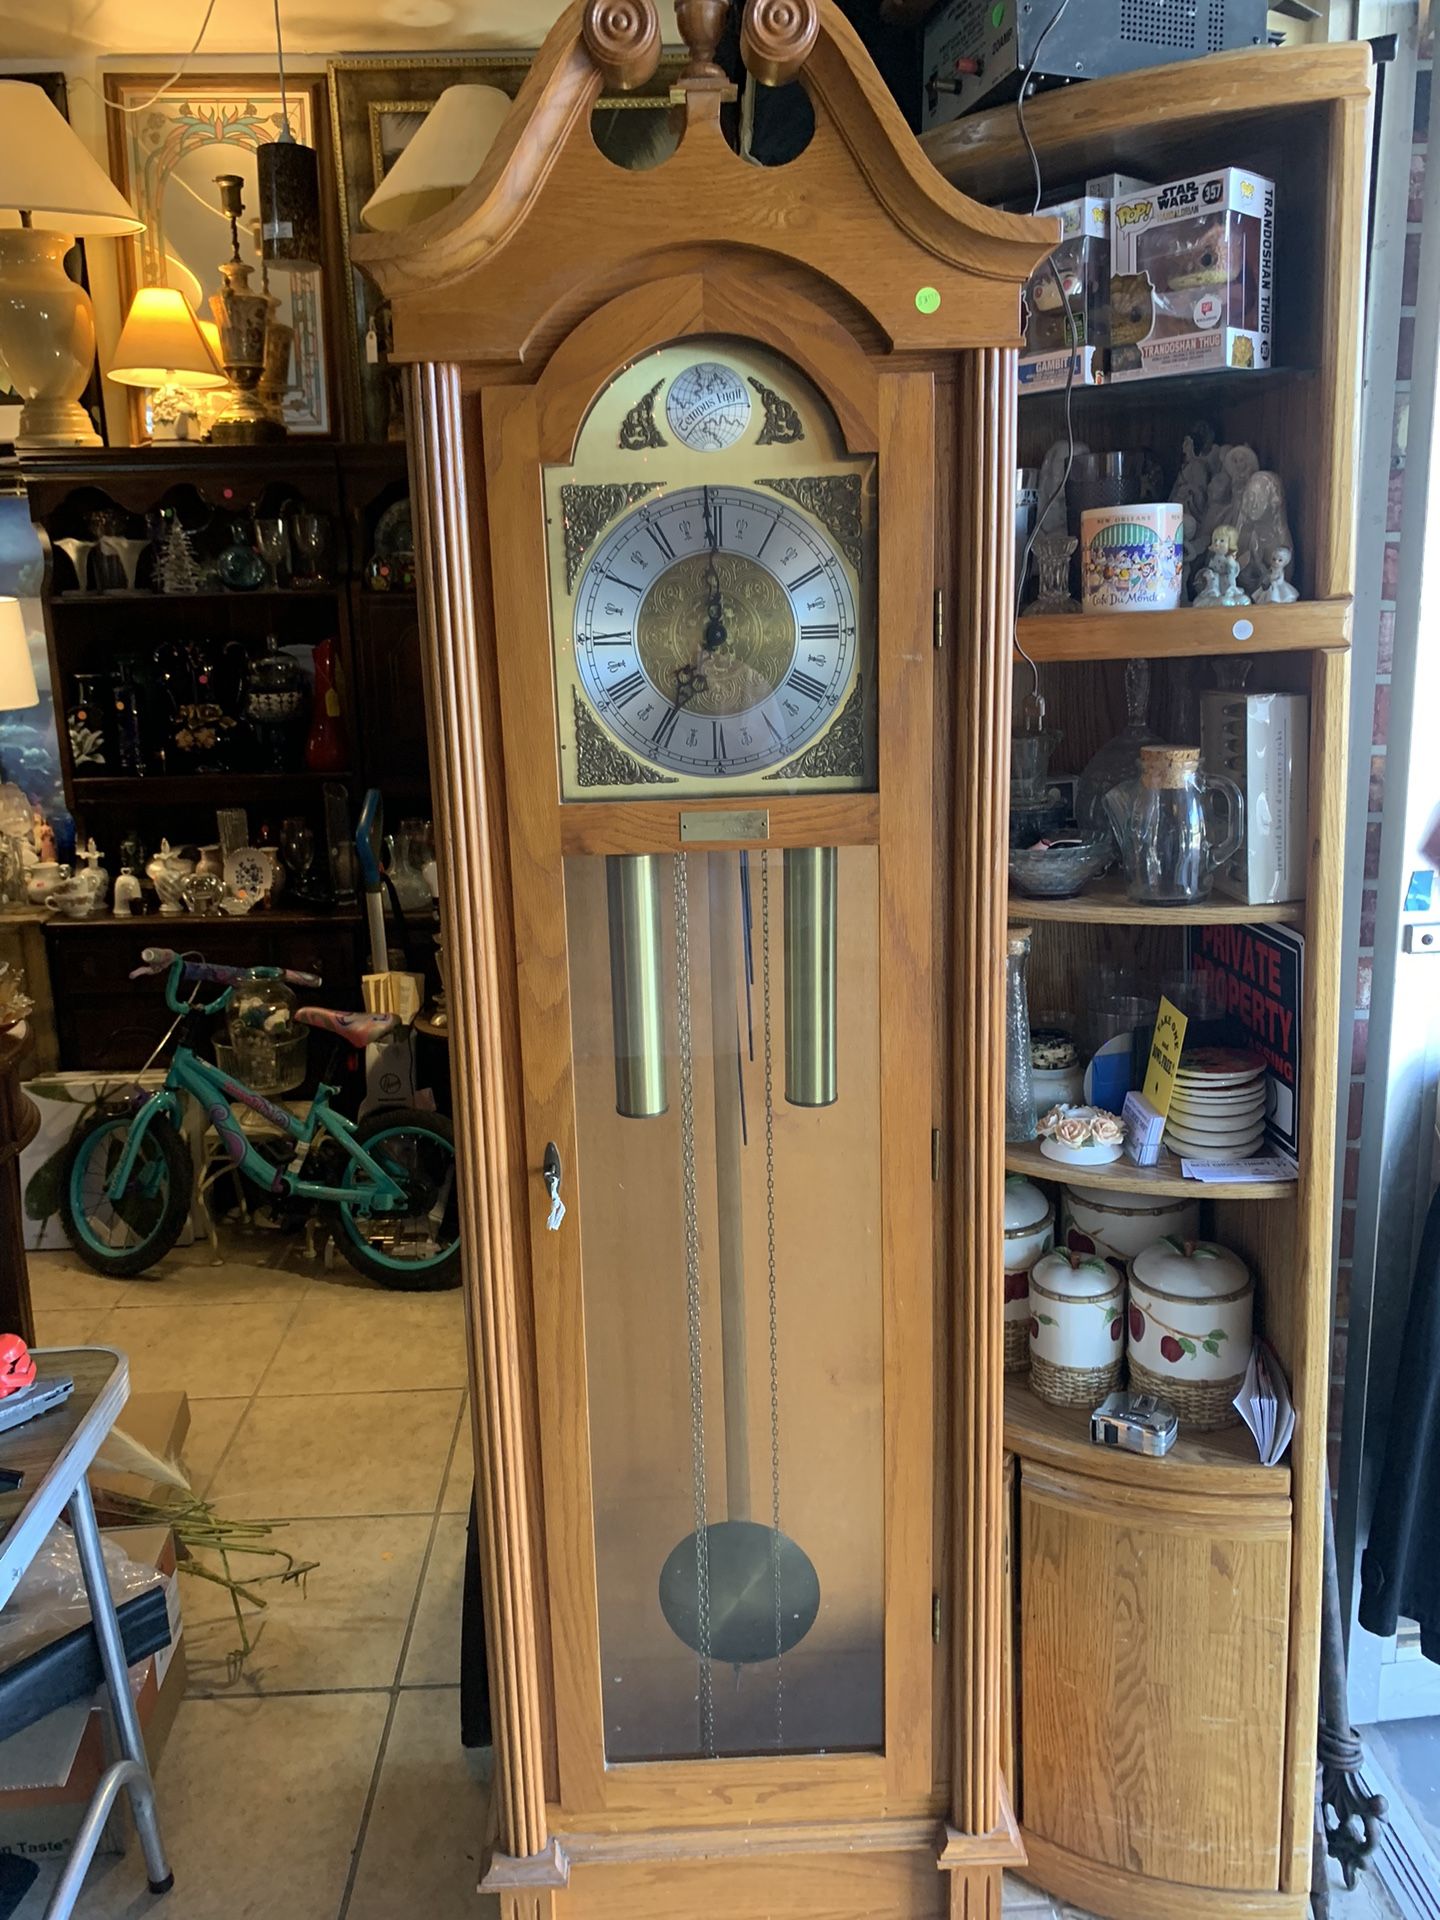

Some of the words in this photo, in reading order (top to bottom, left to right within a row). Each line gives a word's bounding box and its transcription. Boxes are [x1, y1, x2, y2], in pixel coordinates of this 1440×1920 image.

[1157, 192, 1199, 210] WARS
[1158, 181, 1199, 199] STAR
[1204, 182, 1222, 201] 357
[1115, 201, 1153, 229] POP!
[1261, 189, 1274, 290] TRANDOSHAN
[1261, 296, 1271, 334] THUG
[1144, 341, 1197, 358] TRANDOSHAN
[1199, 335, 1221, 348] THUG
[1036, 357, 1067, 373] GAMBIT
[678, 398, 716, 432] Tempus
[1115, 514, 1152, 523] ORLEANS
[785, 564, 824, 593] II
[1110, 593, 1124, 606] Du
[800, 624, 840, 640] III
[606, 670, 648, 709] VIII
[785, 668, 828, 703] IIII
[1203, 924, 1281, 997] PRIVATE
[1193, 952, 1294, 1054] PROPERTY
